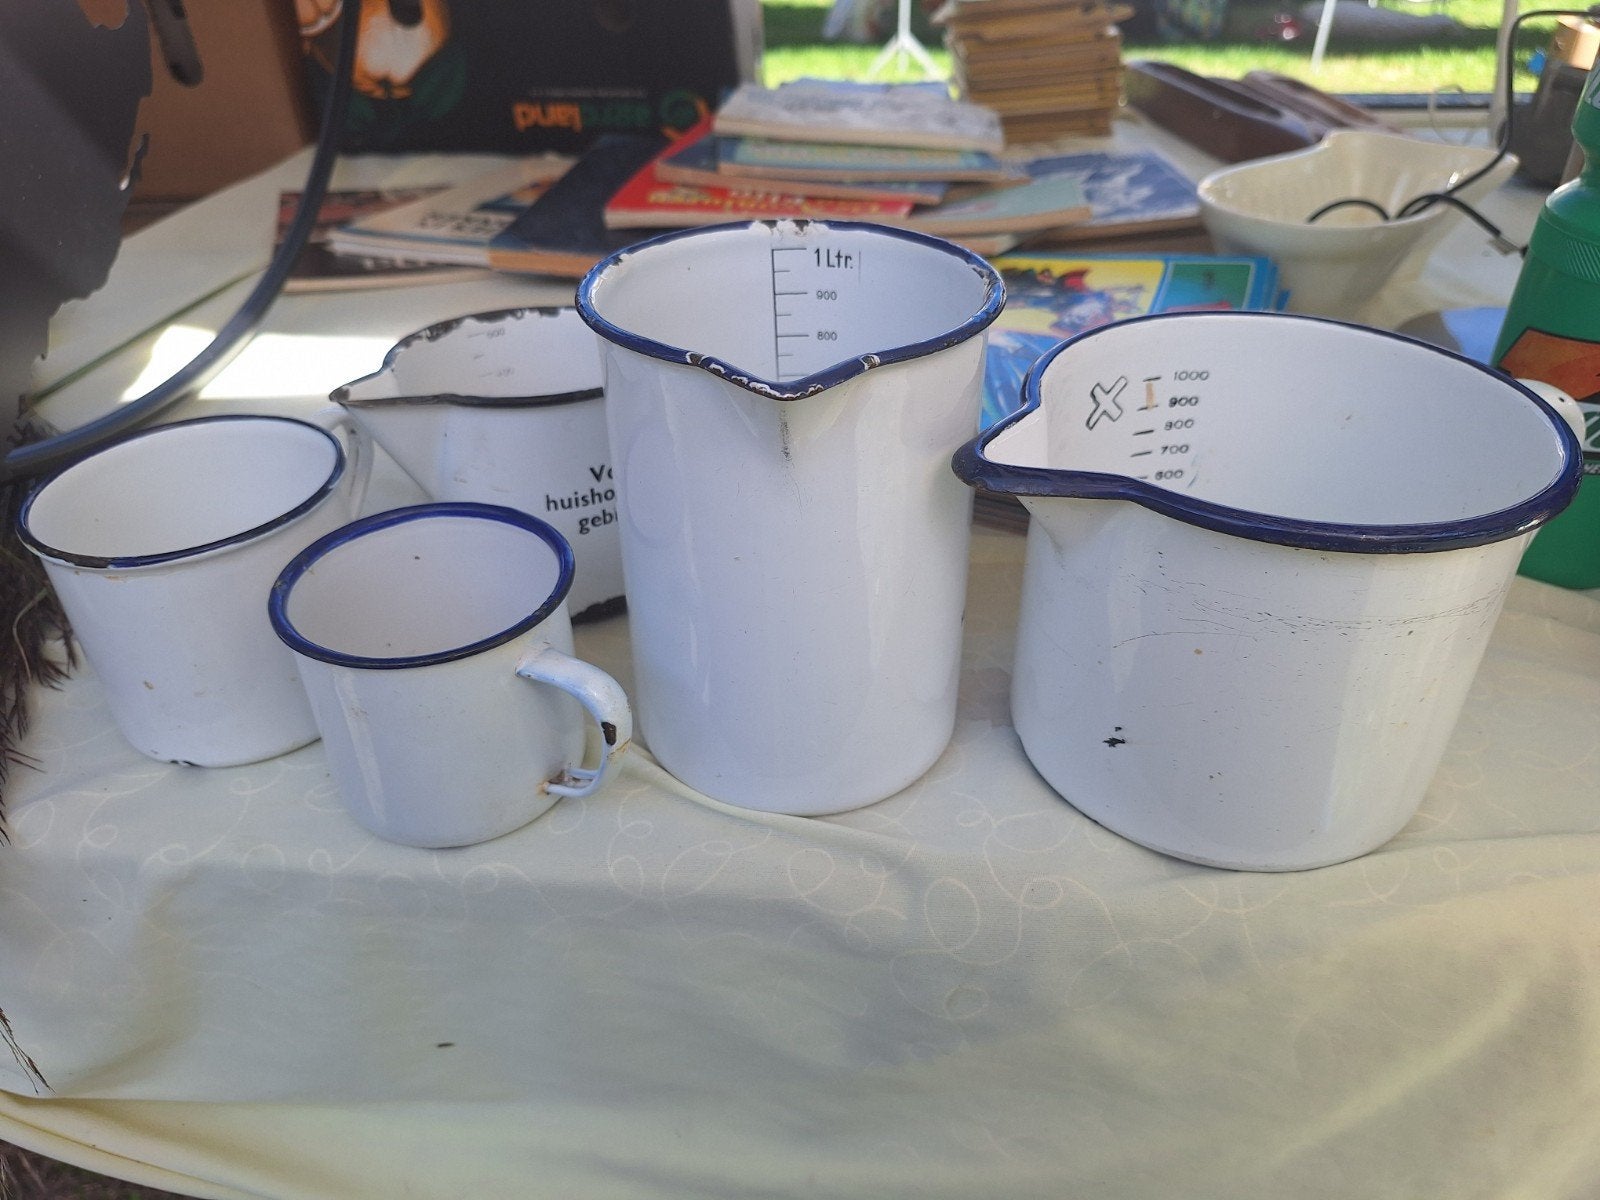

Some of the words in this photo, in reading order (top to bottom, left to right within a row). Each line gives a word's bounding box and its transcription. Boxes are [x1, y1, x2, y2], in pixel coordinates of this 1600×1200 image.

[814, 247, 821, 268] 1
[826, 248, 854, 270] Ltr.
[816, 290, 838, 301] 900
[817, 331, 838, 341] 800
[1173, 371, 1210, 381] 1000
[1168, 396, 1199, 408] 900
[1160, 444, 1189, 454] 700
[546, 487, 616, 513] huisho
